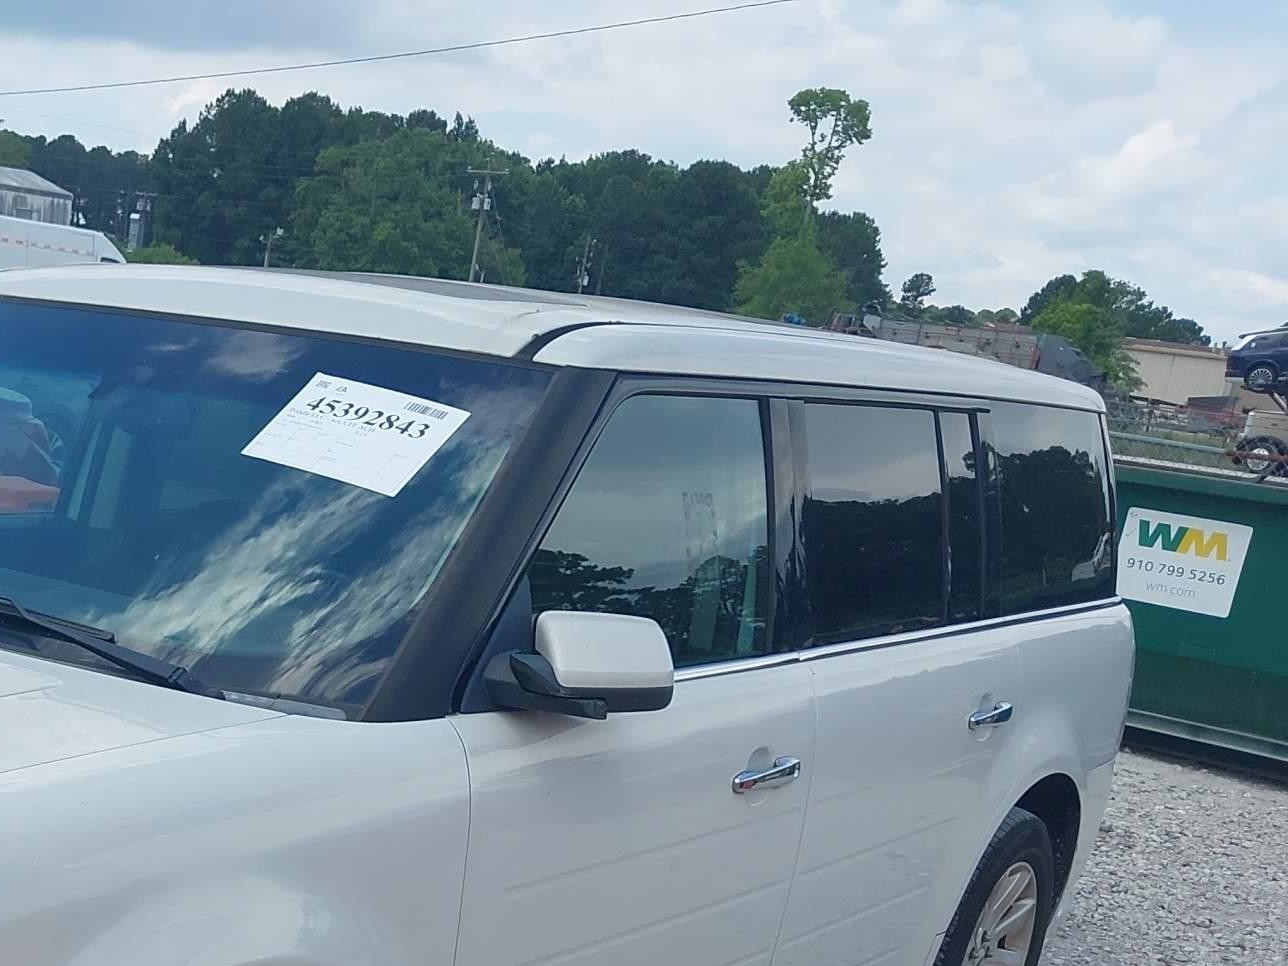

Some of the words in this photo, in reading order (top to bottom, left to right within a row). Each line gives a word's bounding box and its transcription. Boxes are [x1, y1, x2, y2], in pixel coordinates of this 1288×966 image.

[306, 396, 431, 439] 45392843
[1138, 519, 1228, 561] WM
[1127, 557, 1154, 572] 910
[1158, 563, 1185, 577] 799
[1188, 569, 1227, 585] 5256
